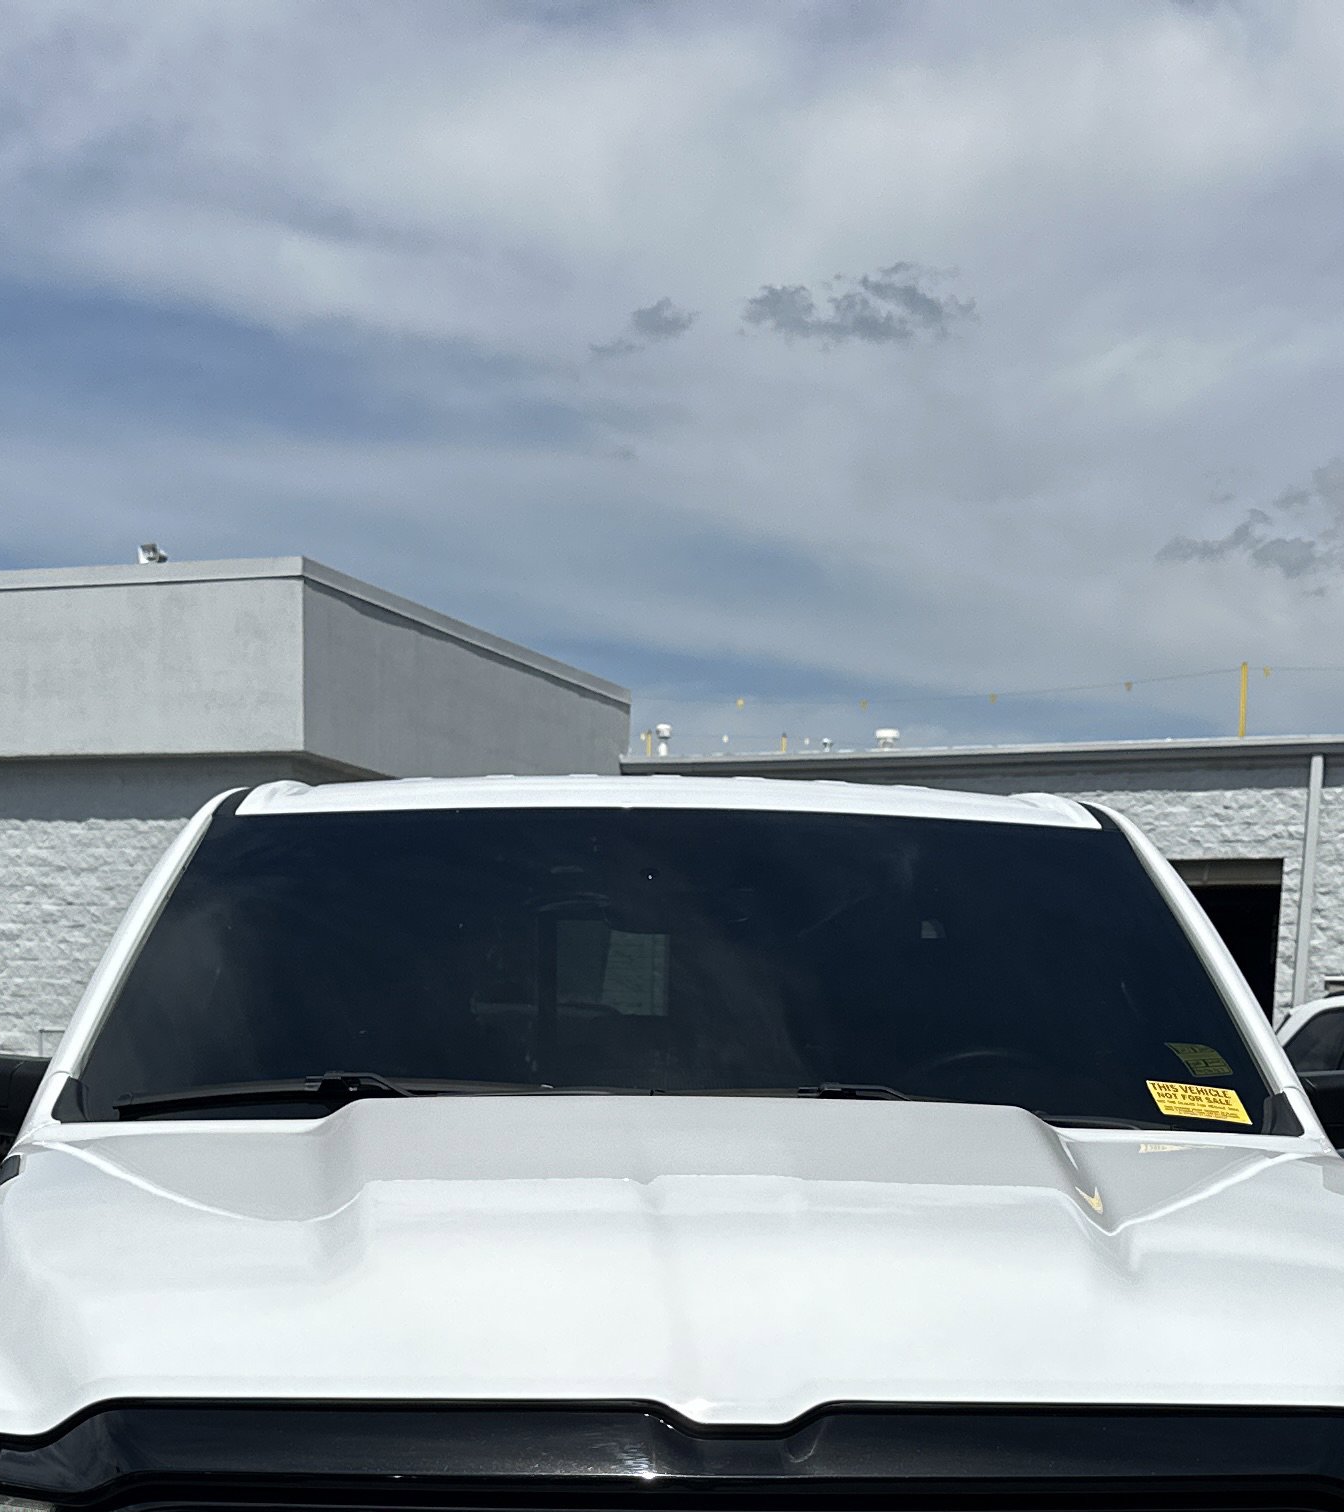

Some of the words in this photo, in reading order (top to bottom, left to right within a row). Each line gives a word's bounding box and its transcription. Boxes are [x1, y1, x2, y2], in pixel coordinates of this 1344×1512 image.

[1149, 1082, 1178, 1093] THIS
[1179, 1085, 1232, 1099] VEHICLE
[1157, 1091, 1177, 1099] NOT
[1181, 1094, 1203, 1103] FOR
[1205, 1096, 1233, 1106] SALE
